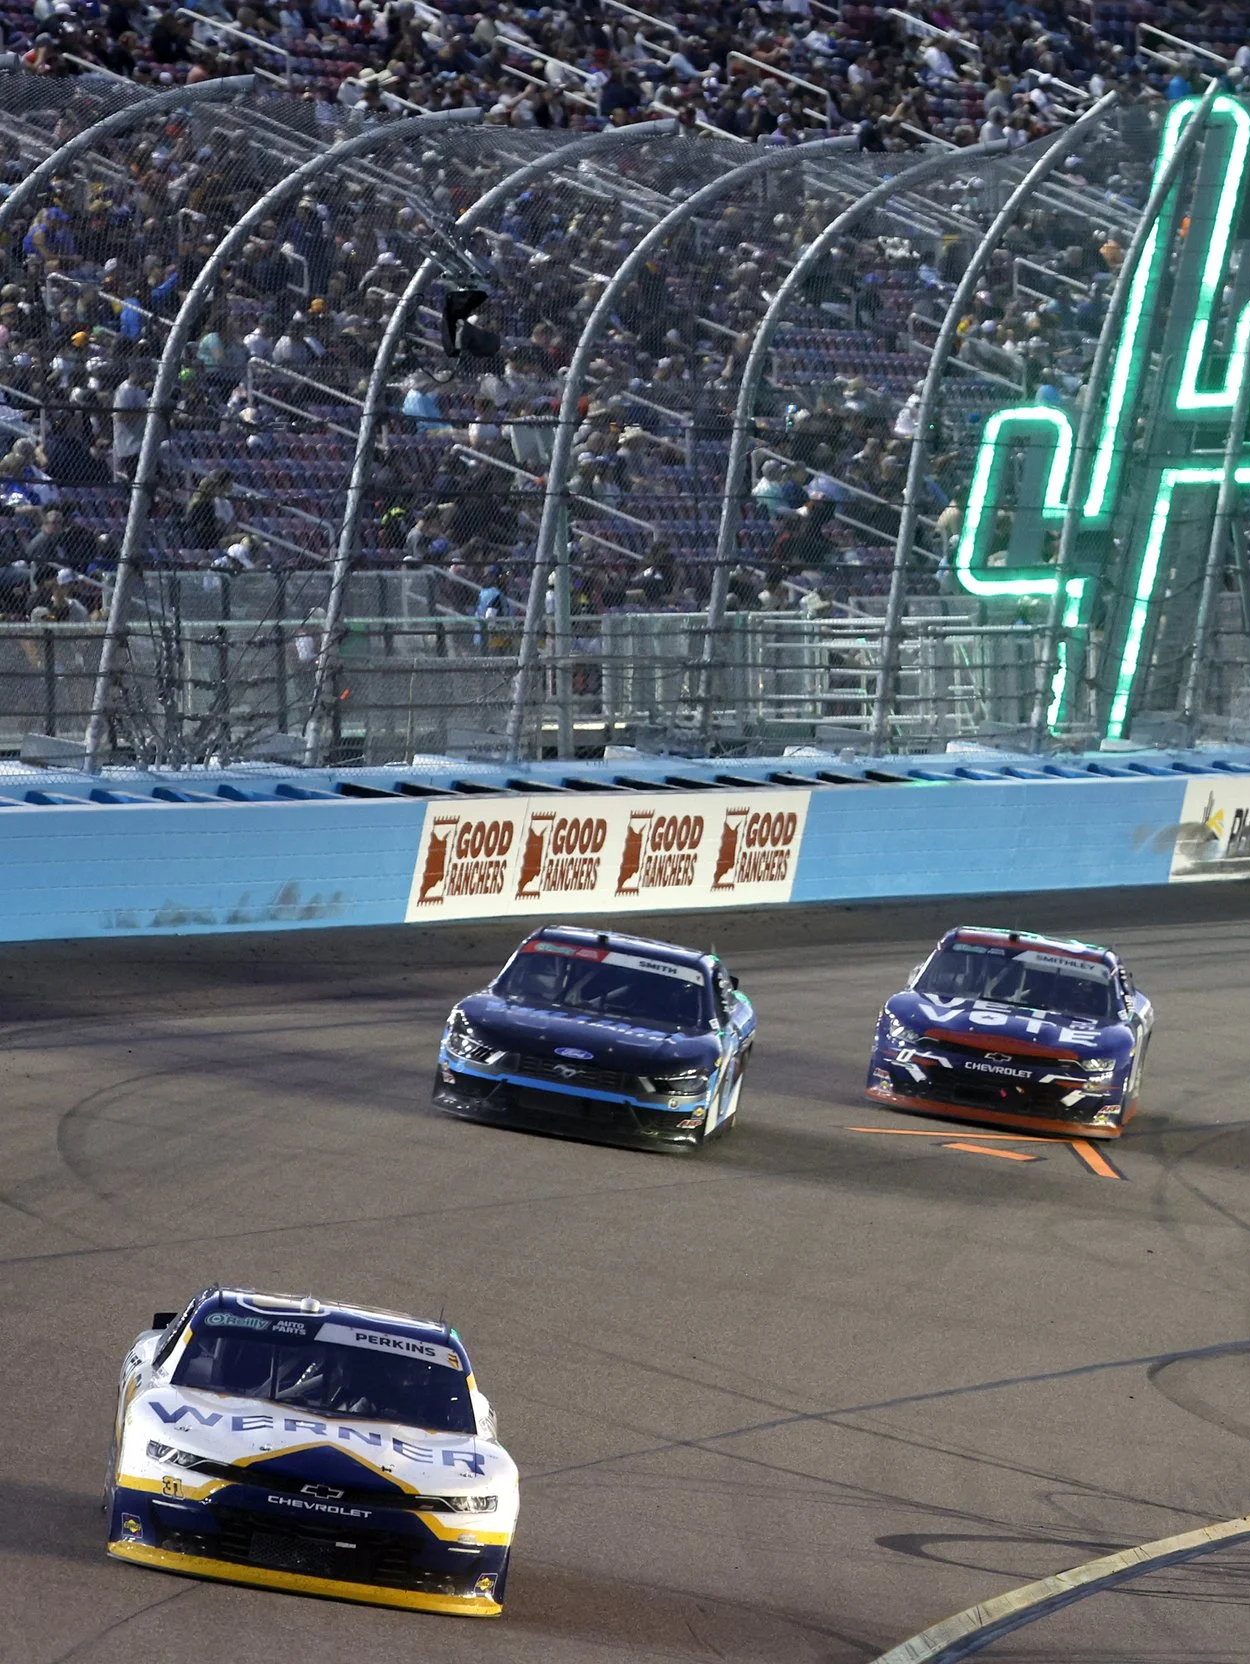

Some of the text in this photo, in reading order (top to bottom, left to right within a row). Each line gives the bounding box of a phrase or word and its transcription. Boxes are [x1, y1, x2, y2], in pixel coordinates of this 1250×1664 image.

[455, 819, 514, 859] GOOD
[552, 817, 608, 855] GOOD
[650, 815, 705, 852] GOOD
[745, 811, 798, 848] GOOD
[446, 859, 508, 896] RANCHERS
[543, 856, 600, 891] RANCHERS
[642, 854, 697, 887] RANCHERS
[737, 849, 791, 883] RANCHERS
[638, 960, 679, 975] SMITH
[1035, 954, 1096, 971] SMITHLEY
[918, 1003, 1102, 1047] VOTE
[964, 1060, 1033, 1079] CHEVROLET
[272, 1325, 307, 1336] PARTS
[276, 1320, 305, 1330] AUTO
[355, 1332, 437, 1357] PERKINS
[148, 1401, 486, 1477] WERNER
[162, 1475, 185, 1500] 31
[267, 1494, 373, 1519] CHEVROLET
